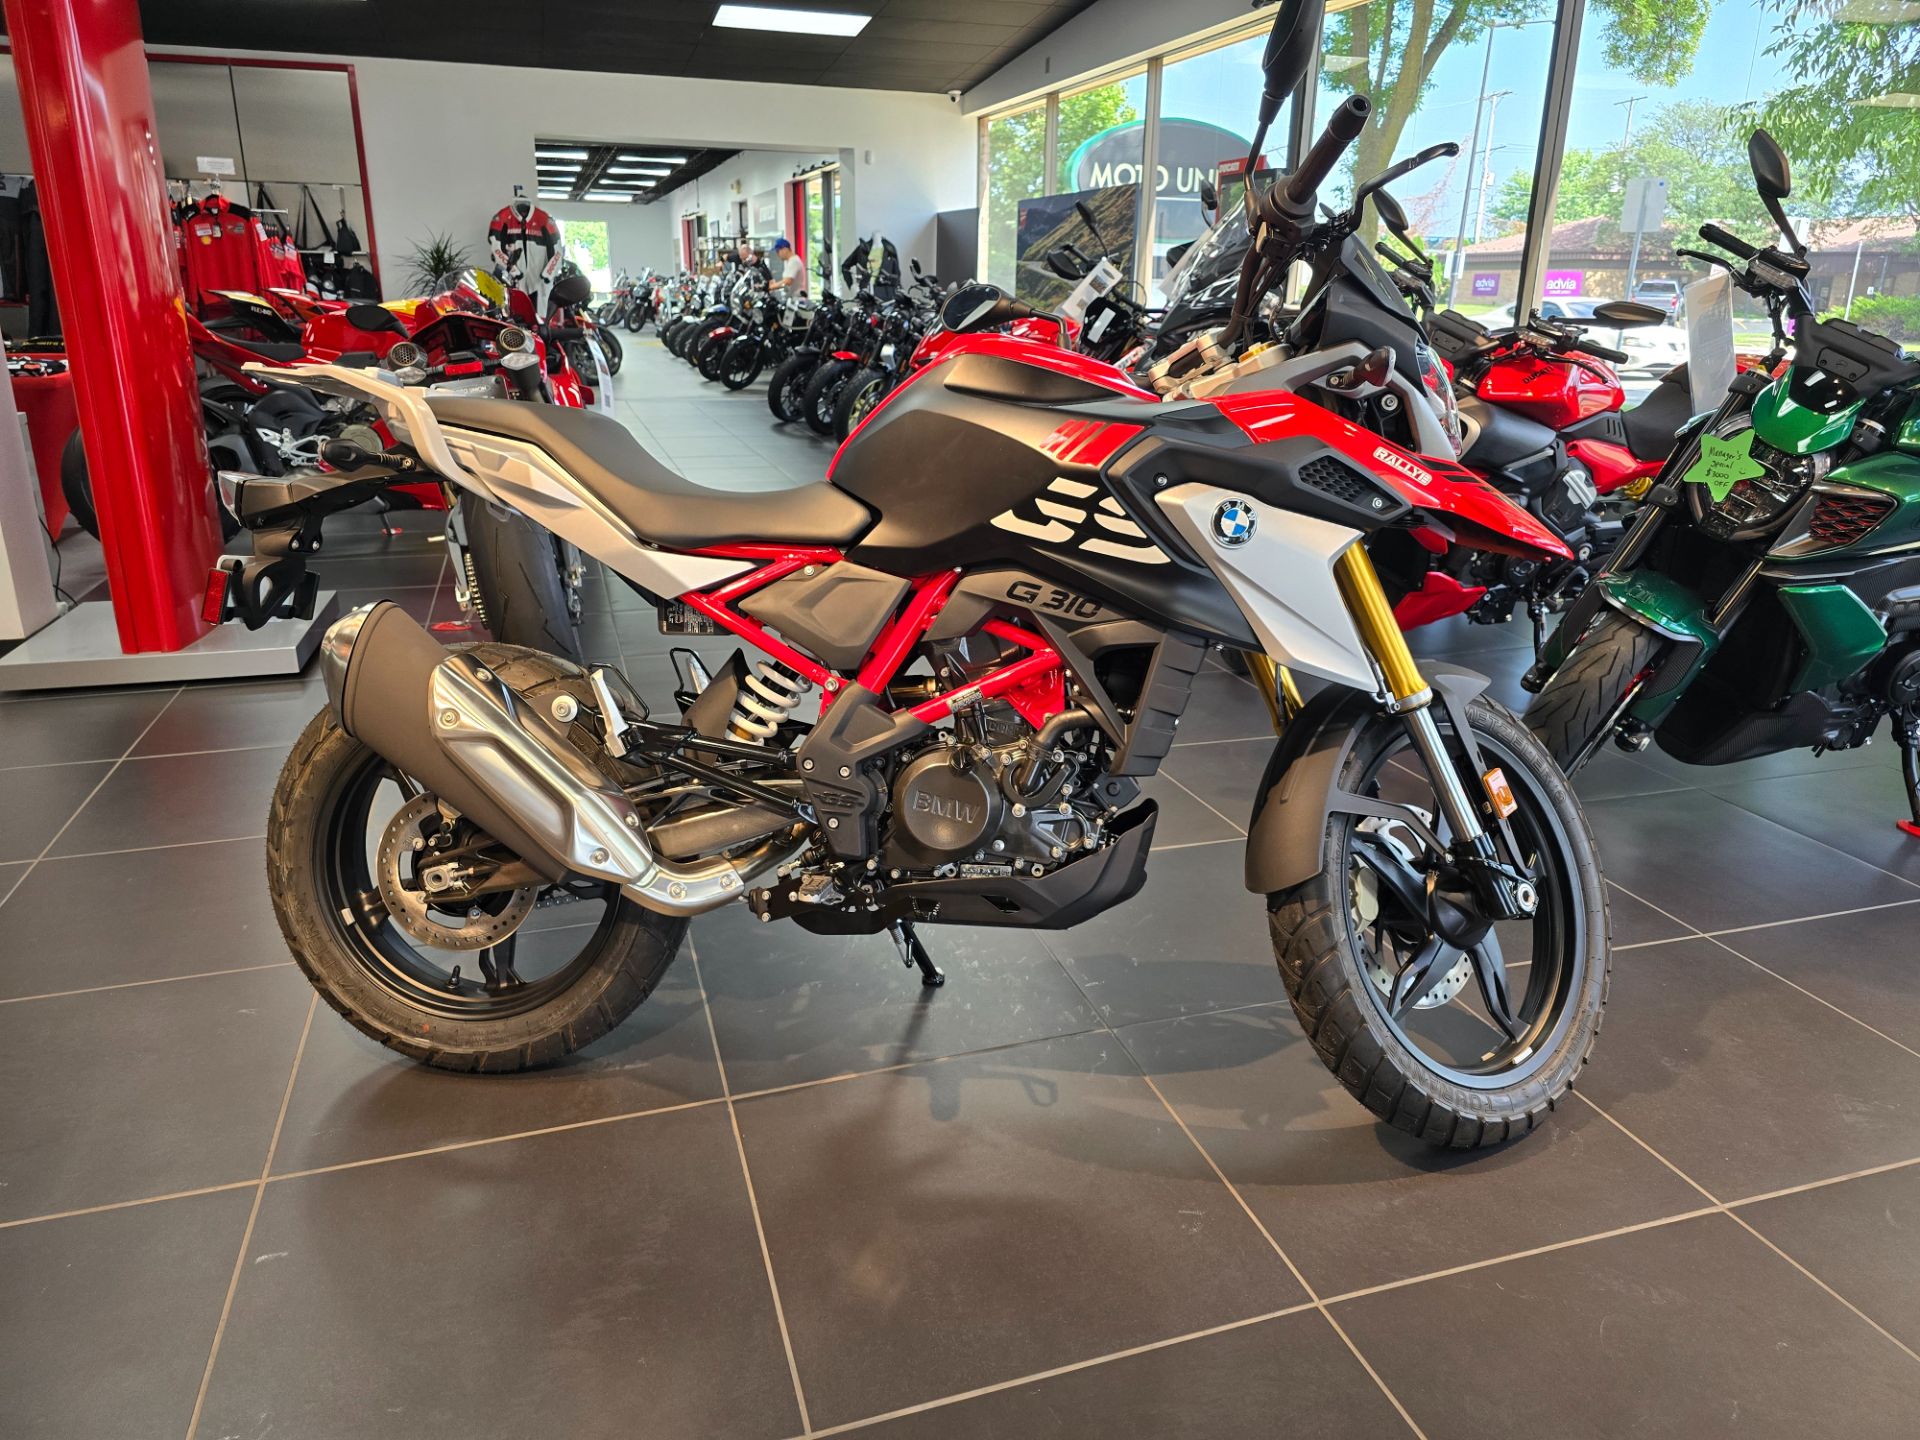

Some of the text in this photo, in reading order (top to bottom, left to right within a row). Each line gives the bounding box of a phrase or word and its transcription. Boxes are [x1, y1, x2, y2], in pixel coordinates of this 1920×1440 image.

[1475, 278, 1495, 288] advia
[1546, 277, 1577, 290] advia
[1523, 366, 1554, 384] DUCATI
[1374, 447, 1432, 485] RALLYE
[1222, 500, 1256, 521] BMW
[1006, 580, 1103, 618] G 310
[1464, 704, 1554, 785] METZELER
[912, 790, 981, 824] BMW
